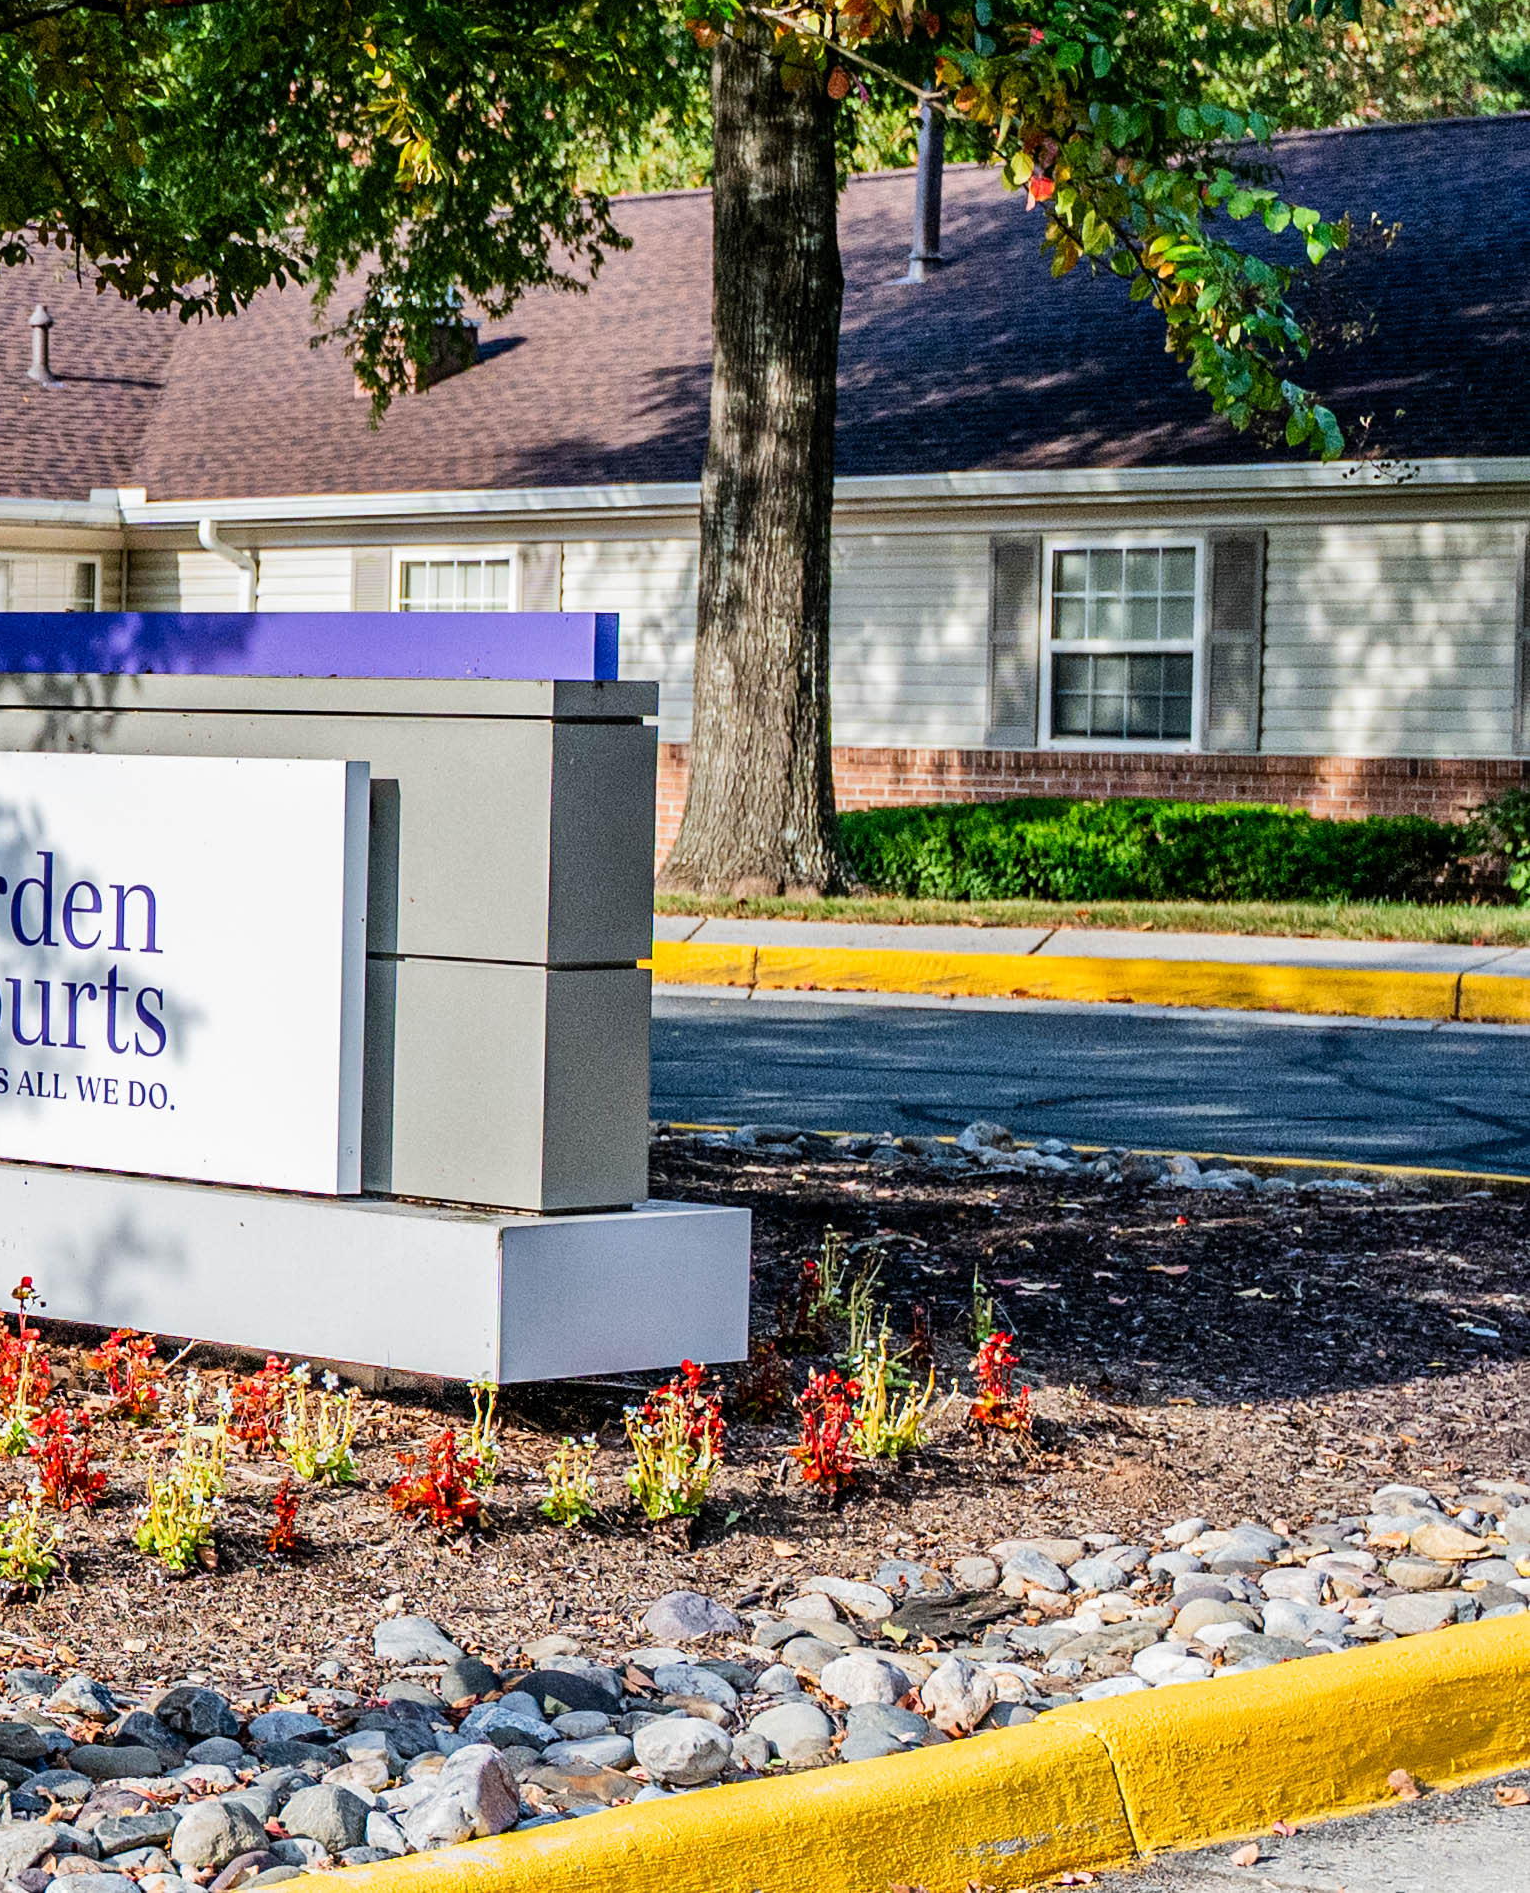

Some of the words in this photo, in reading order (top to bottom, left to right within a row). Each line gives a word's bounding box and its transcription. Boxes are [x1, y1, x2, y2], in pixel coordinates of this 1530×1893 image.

[16, 1070, 67, 1100] ALL
[75, 1075, 119, 1105] WE
[127, 1079, 175, 1111] DO.
